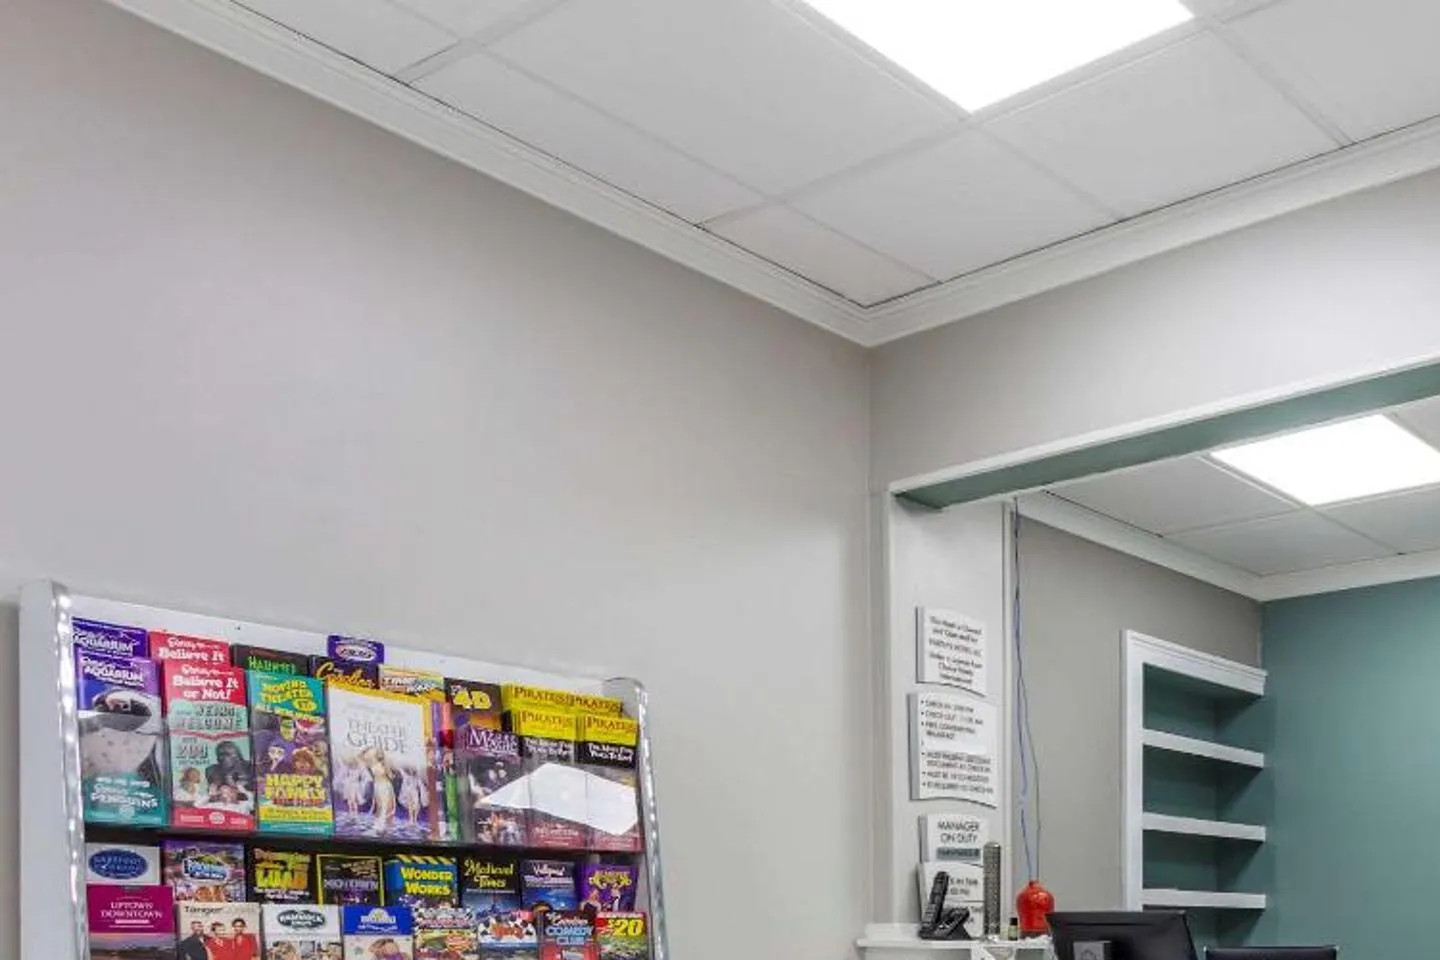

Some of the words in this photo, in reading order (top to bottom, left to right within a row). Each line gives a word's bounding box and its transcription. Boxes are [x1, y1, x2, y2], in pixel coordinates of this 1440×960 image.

[171, 674, 223, 689] Believe
[226, 677, 239, 689] It
[937, 820, 980, 832] MANAGER
[401, 867, 453, 881] WONDER
[406, 881, 451, 896] WORKS
[110, 901, 154, 910] UPTOWN
